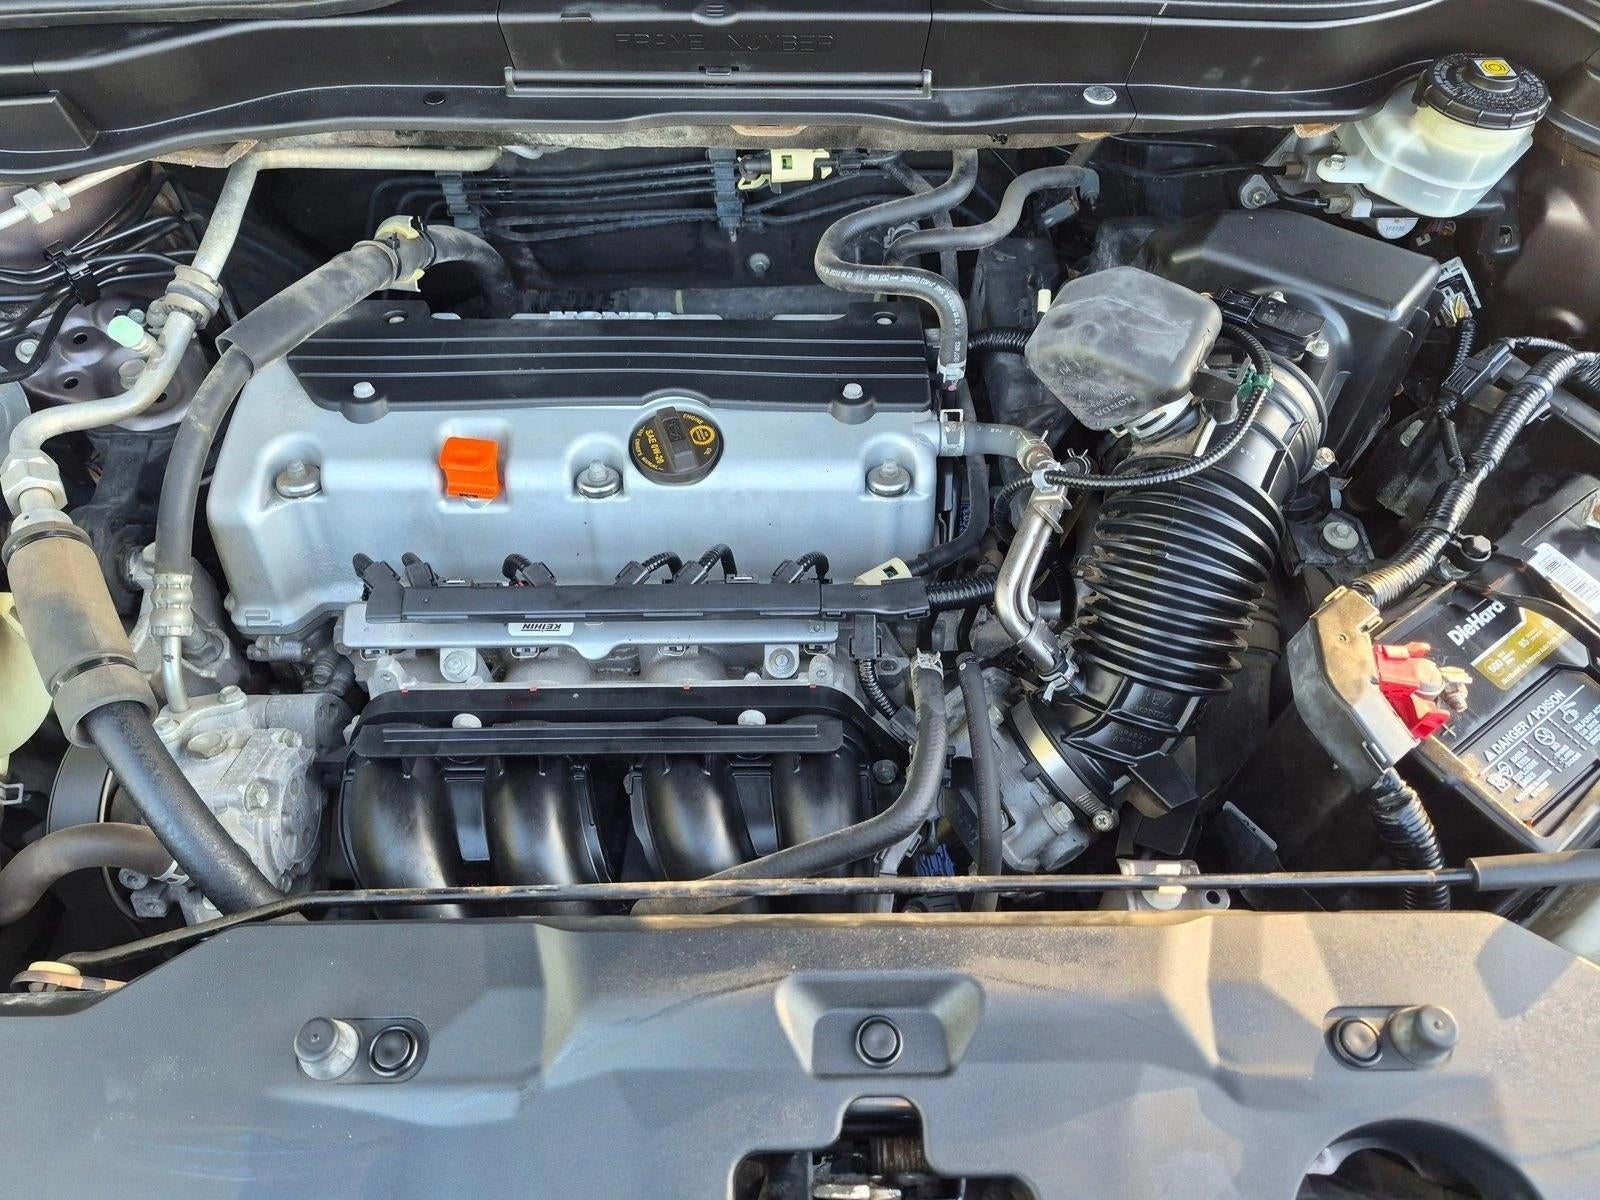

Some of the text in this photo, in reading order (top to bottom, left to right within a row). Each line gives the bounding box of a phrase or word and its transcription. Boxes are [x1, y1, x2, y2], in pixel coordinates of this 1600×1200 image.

[615, 33, 835, 51] FRAME NUMBER
[900, 274, 922, 284] ENGINE
[1093, 395, 1137, 417] HONDA
[682, 413, 704, 425] ENGINE
[645, 429, 665, 464] SAE 0W-20
[1446, 600, 1506, 646] DieHard
[1490, 720, 1530, 755] DANGER
[1531, 689, 1566, 720] POISON
